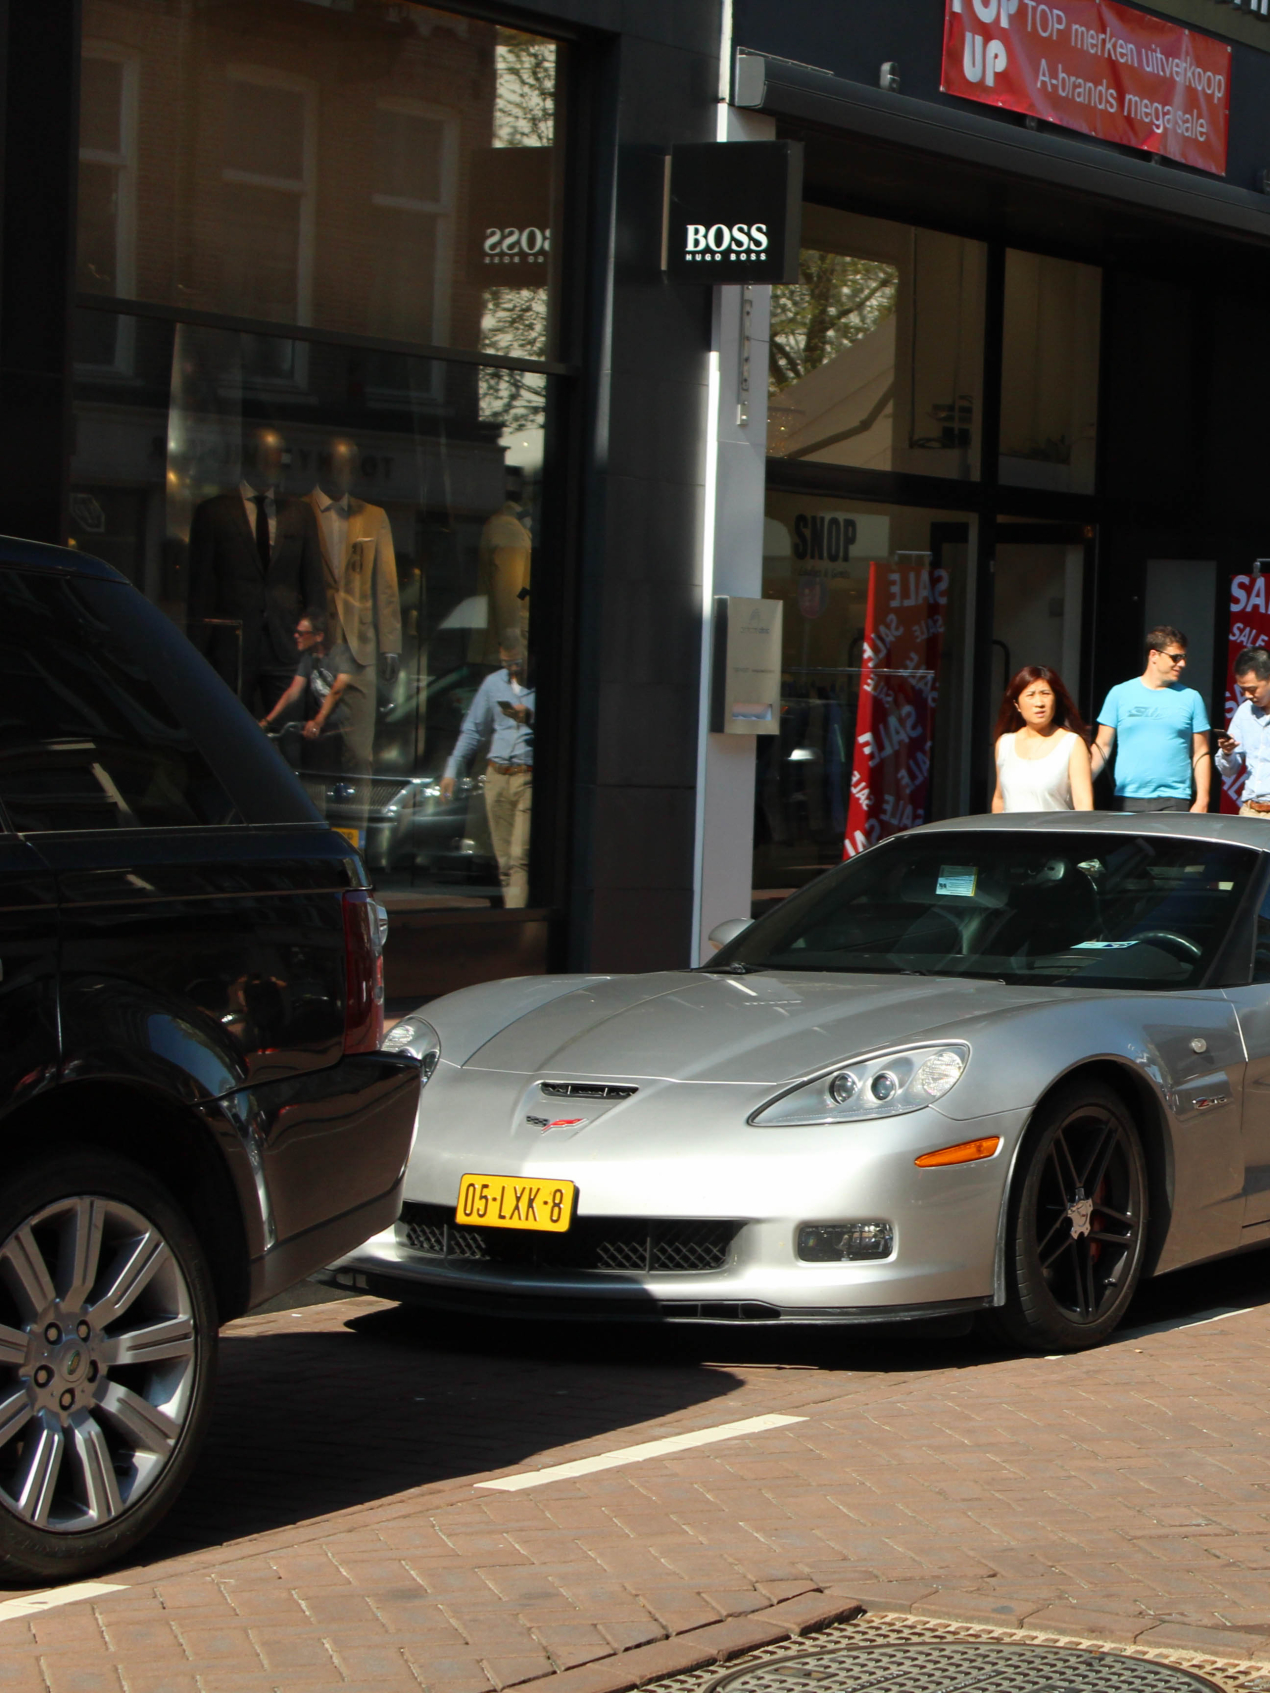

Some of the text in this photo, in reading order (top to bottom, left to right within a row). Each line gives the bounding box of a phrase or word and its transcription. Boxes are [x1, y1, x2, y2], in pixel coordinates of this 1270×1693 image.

[963, 31, 1007, 87] UP
[1023, 0, 1225, 103] TOP merken uitverkoop
[1037, 58, 1117, 113] A-brands
[685, 223, 769, 251] BOSS
[685, 253, 767, 261] HUGO BOSS
[462, 1182, 564, 1224] 05-LXK-8
